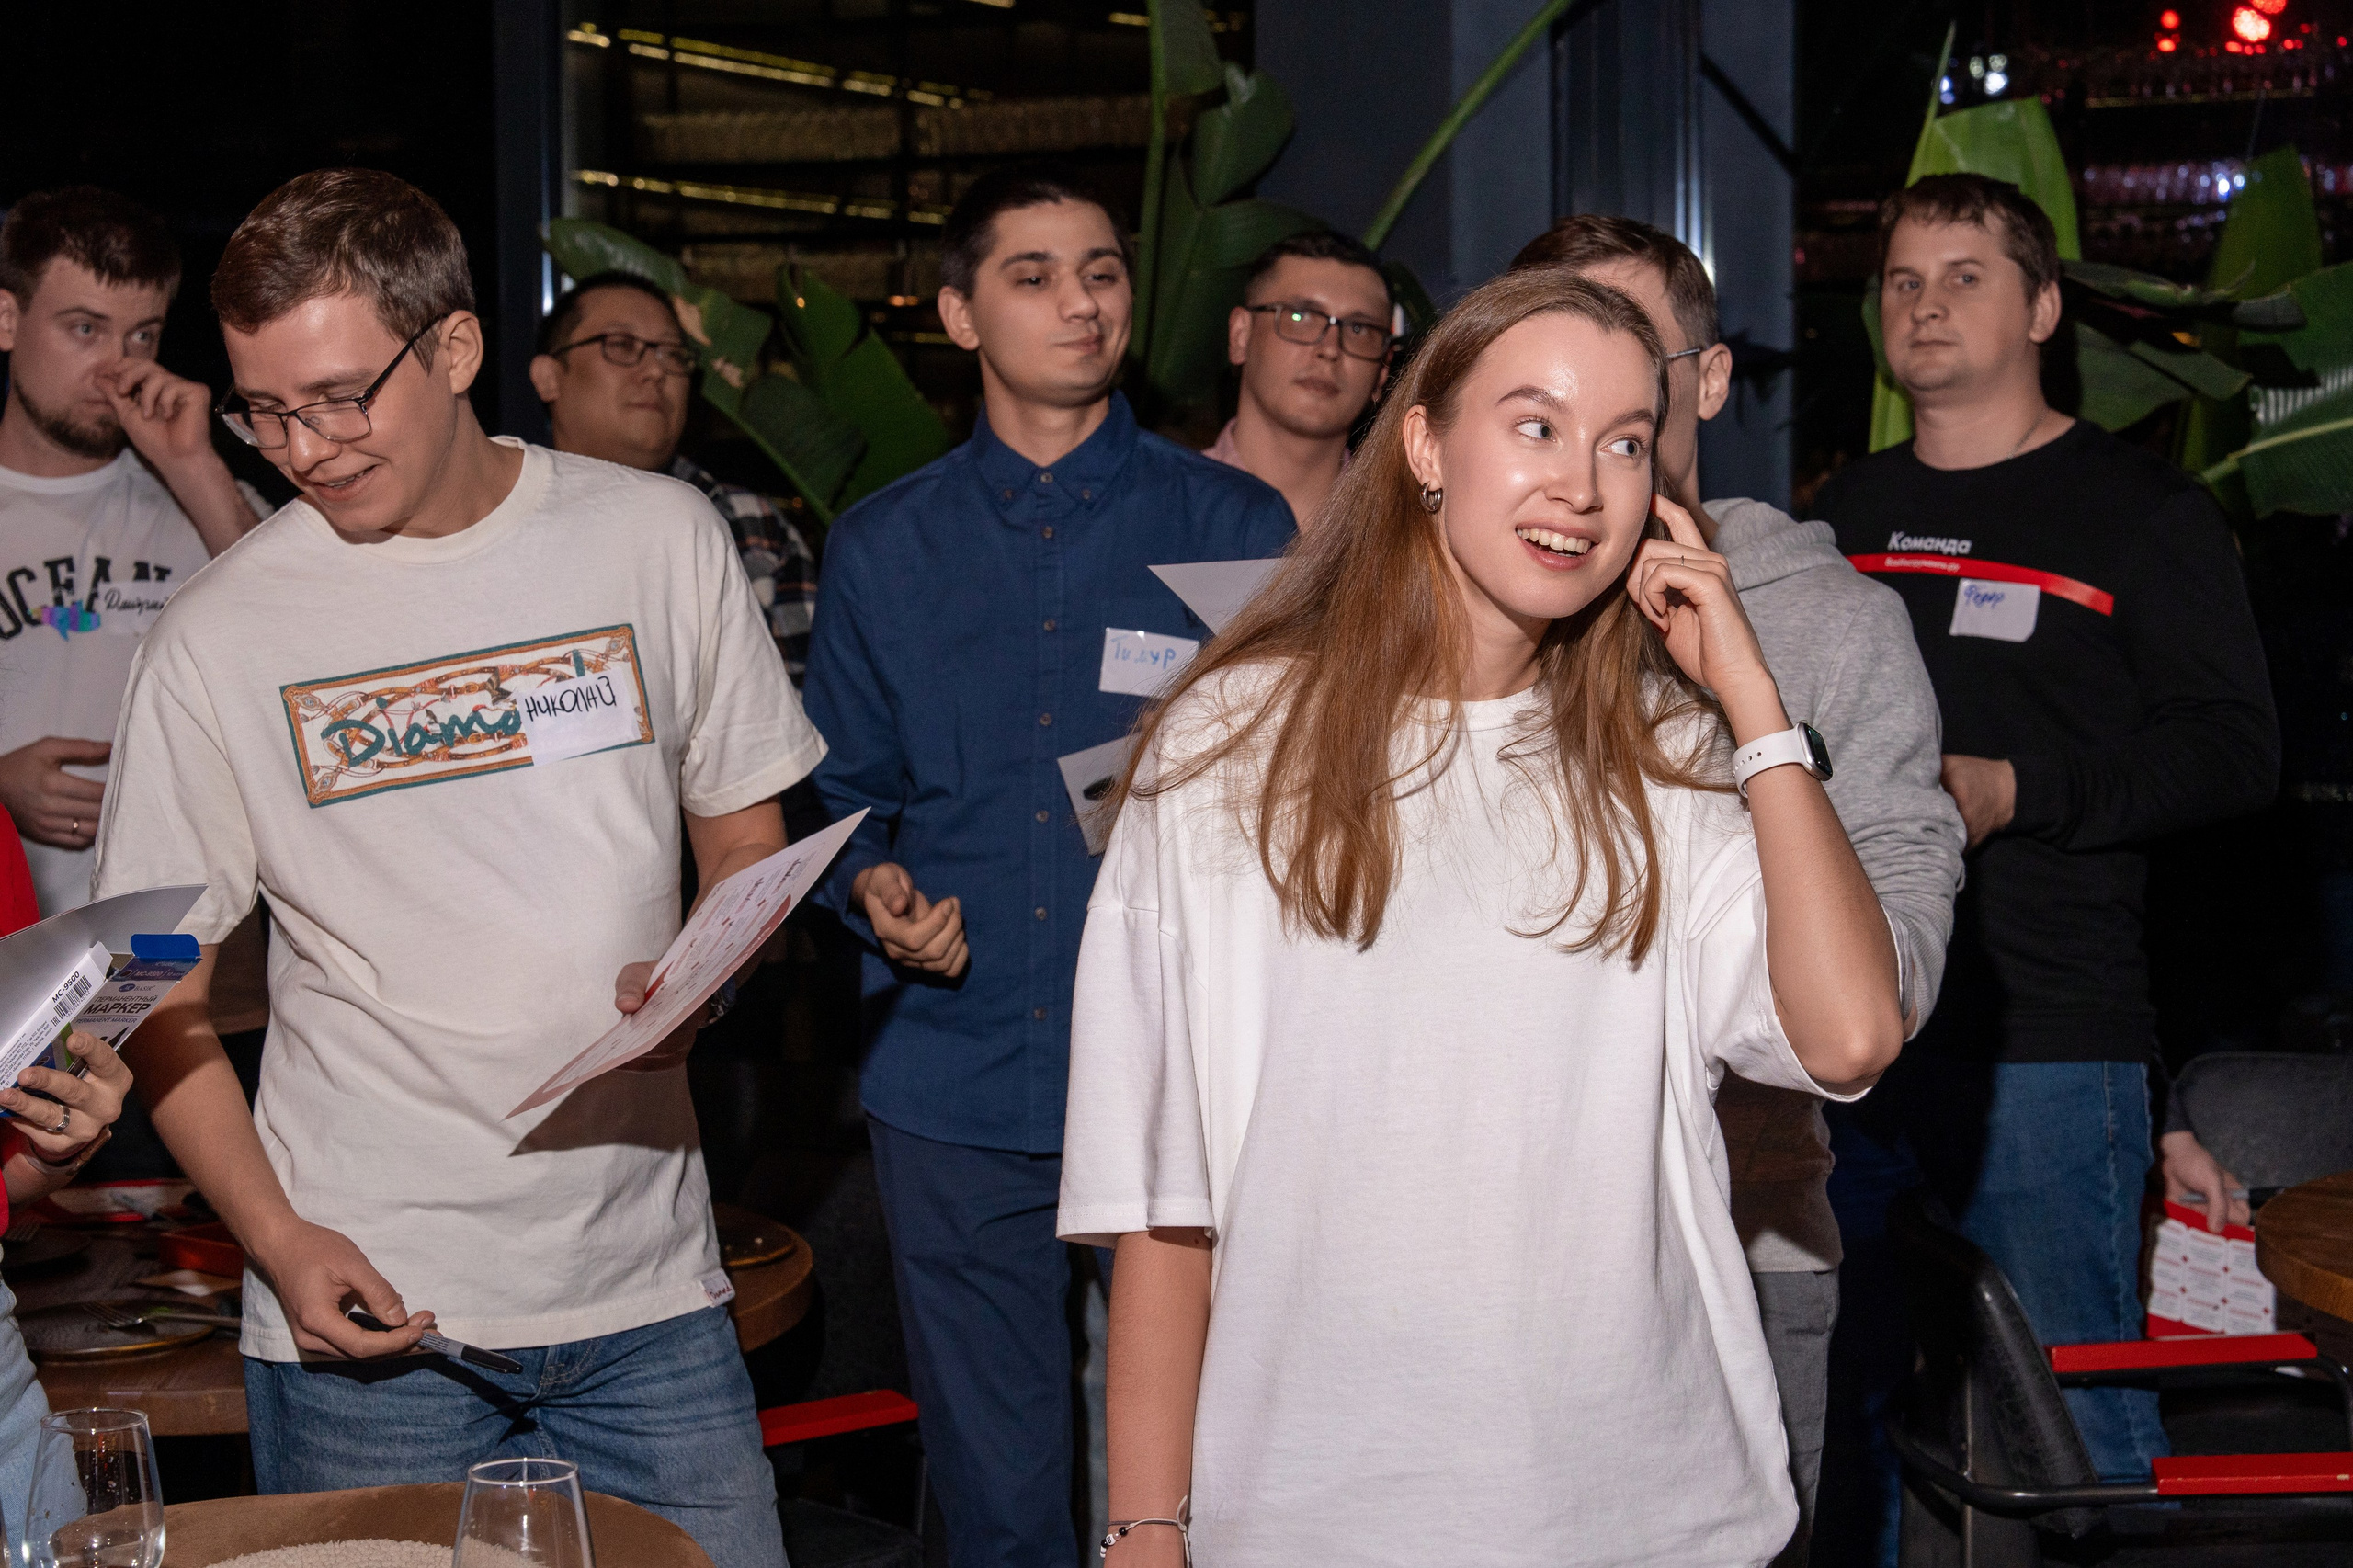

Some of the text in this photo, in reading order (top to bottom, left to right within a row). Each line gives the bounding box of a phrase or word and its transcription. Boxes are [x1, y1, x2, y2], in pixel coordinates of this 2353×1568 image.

[1887, 531, 1972, 556] Команда
[1110, 635, 1176, 670] Тимур
[525, 676, 618, 722] НИКОЛАЙ
[51, 971, 80, 1004] MC-9500
[94, 994, 158, 1004] ПЕРМАНЕНТНЫЙ
[75, 1017, 111, 1025] PERMANENT
[84, 1002, 151, 1015] МАРКЕР
